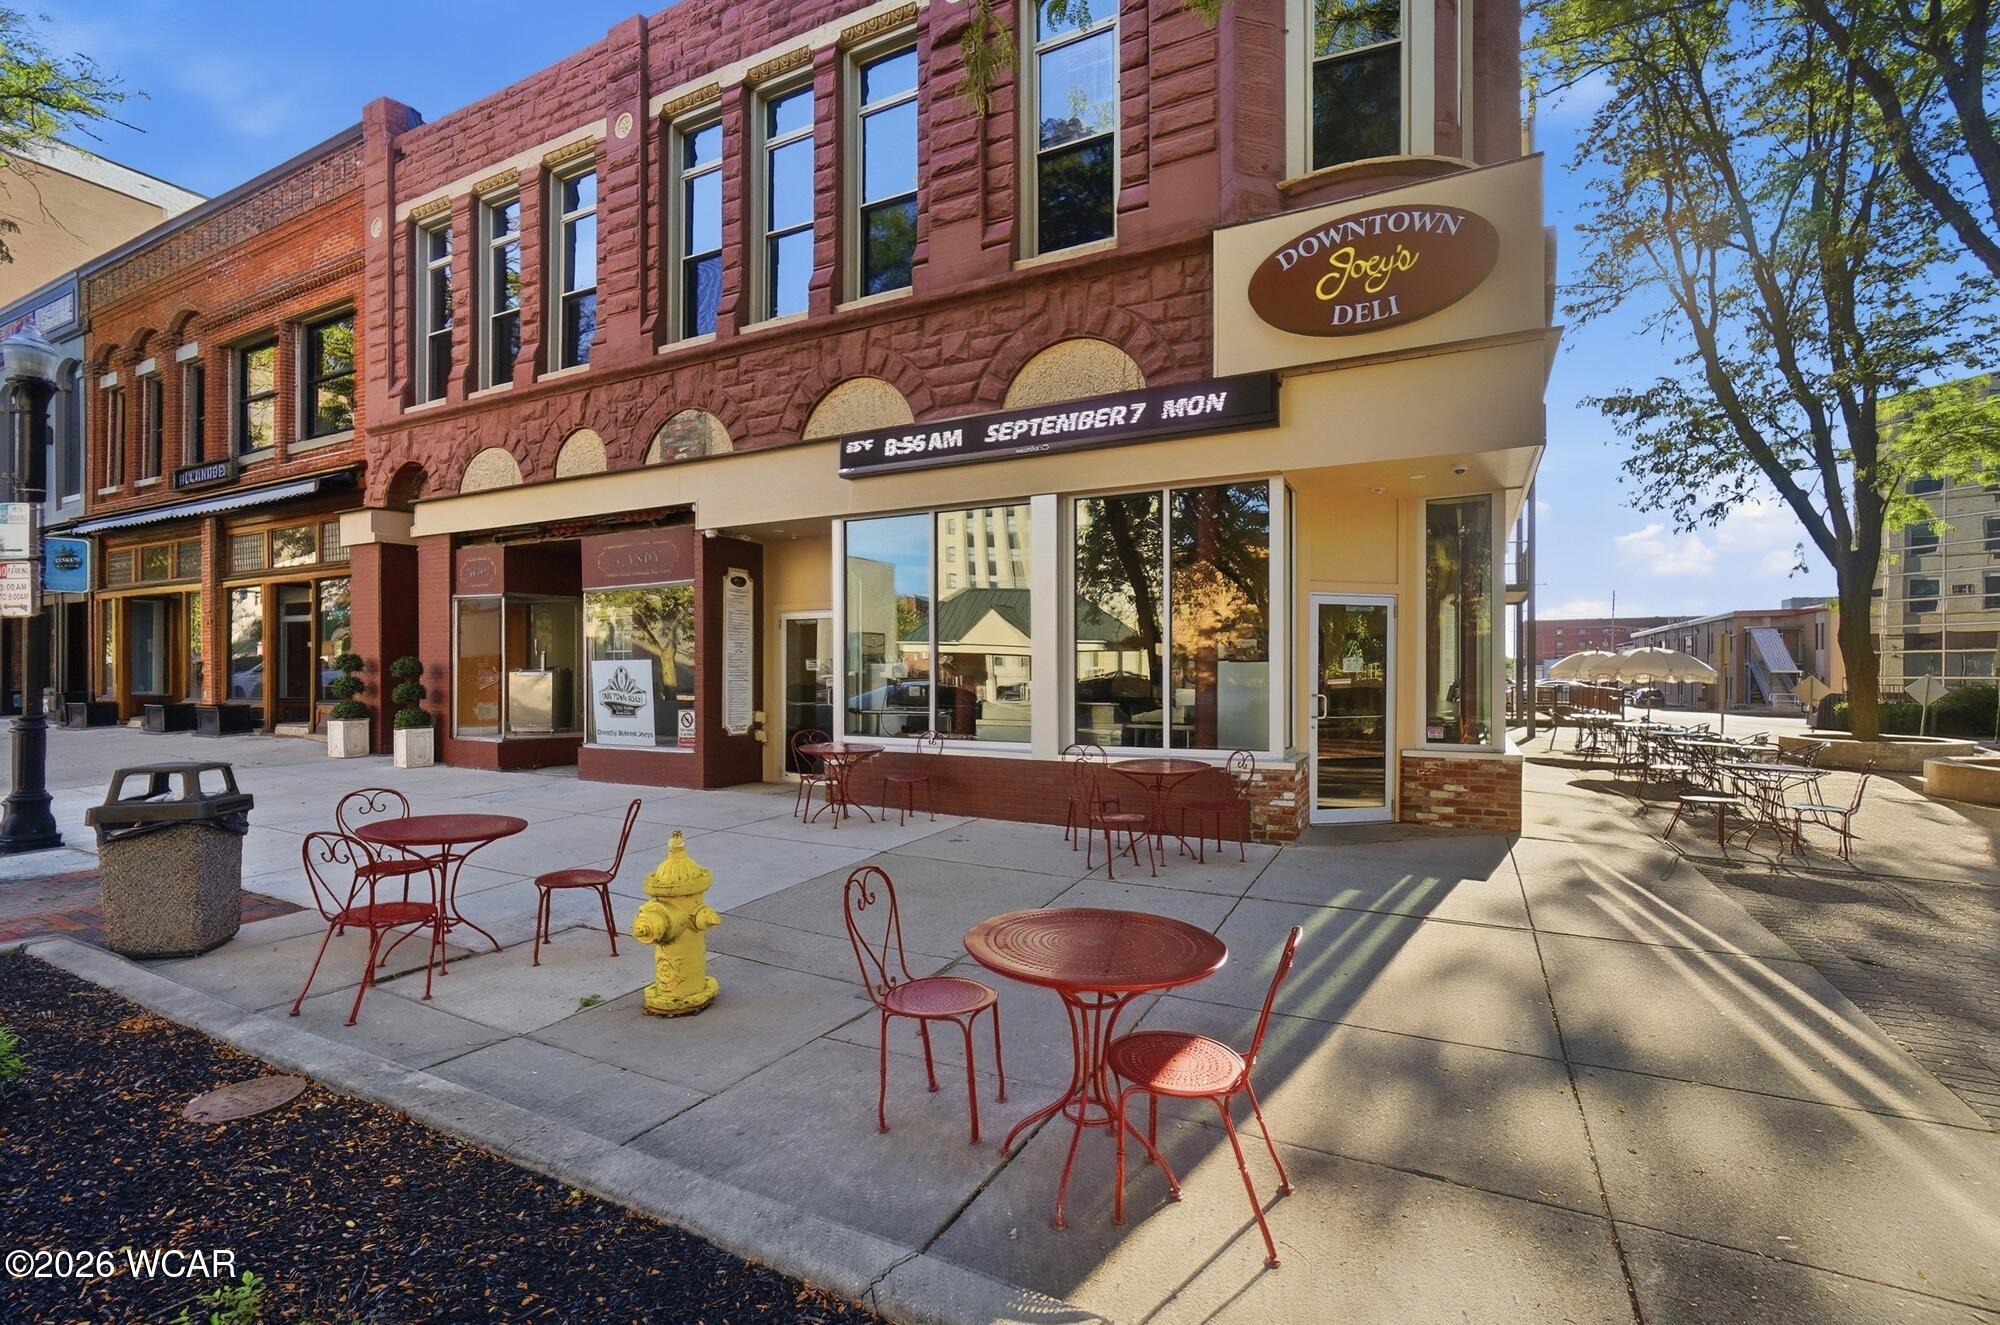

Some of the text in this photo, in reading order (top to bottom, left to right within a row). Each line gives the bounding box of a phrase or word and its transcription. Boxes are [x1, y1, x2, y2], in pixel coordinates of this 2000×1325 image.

[1275, 211, 1466, 272] DOWNTOWN
[1315, 244, 1420, 301] Joey's
[1331, 295, 1401, 326] DELI
[984, 406, 1128, 443] SEPTEMBER
[1161, 392, 1228, 420] MON
